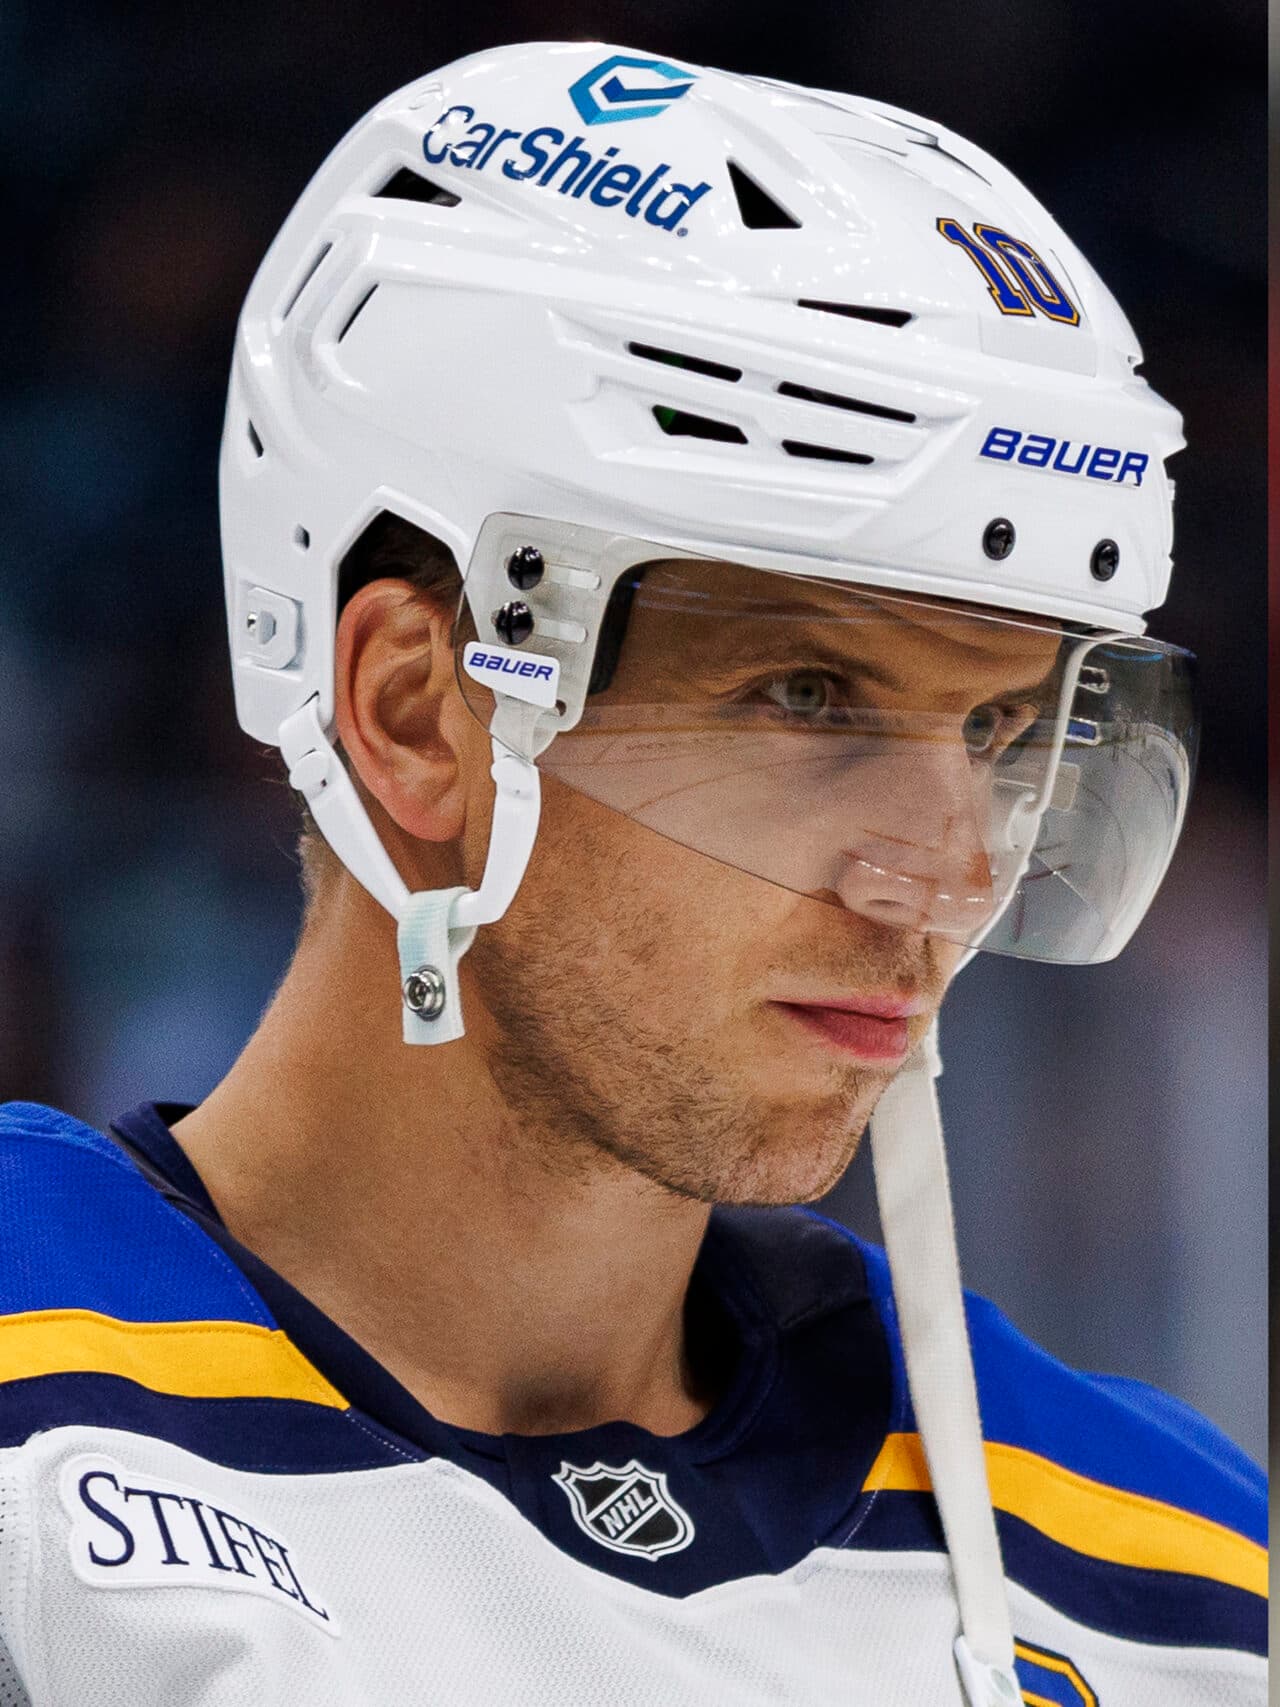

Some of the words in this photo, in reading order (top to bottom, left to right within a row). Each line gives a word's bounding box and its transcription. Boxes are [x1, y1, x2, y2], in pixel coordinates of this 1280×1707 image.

[422, 105, 713, 232] CarShield
[936, 217, 1081, 327] 10
[78, 1471, 330, 1621] STIFEL
[600, 1488, 654, 1538] NHL
